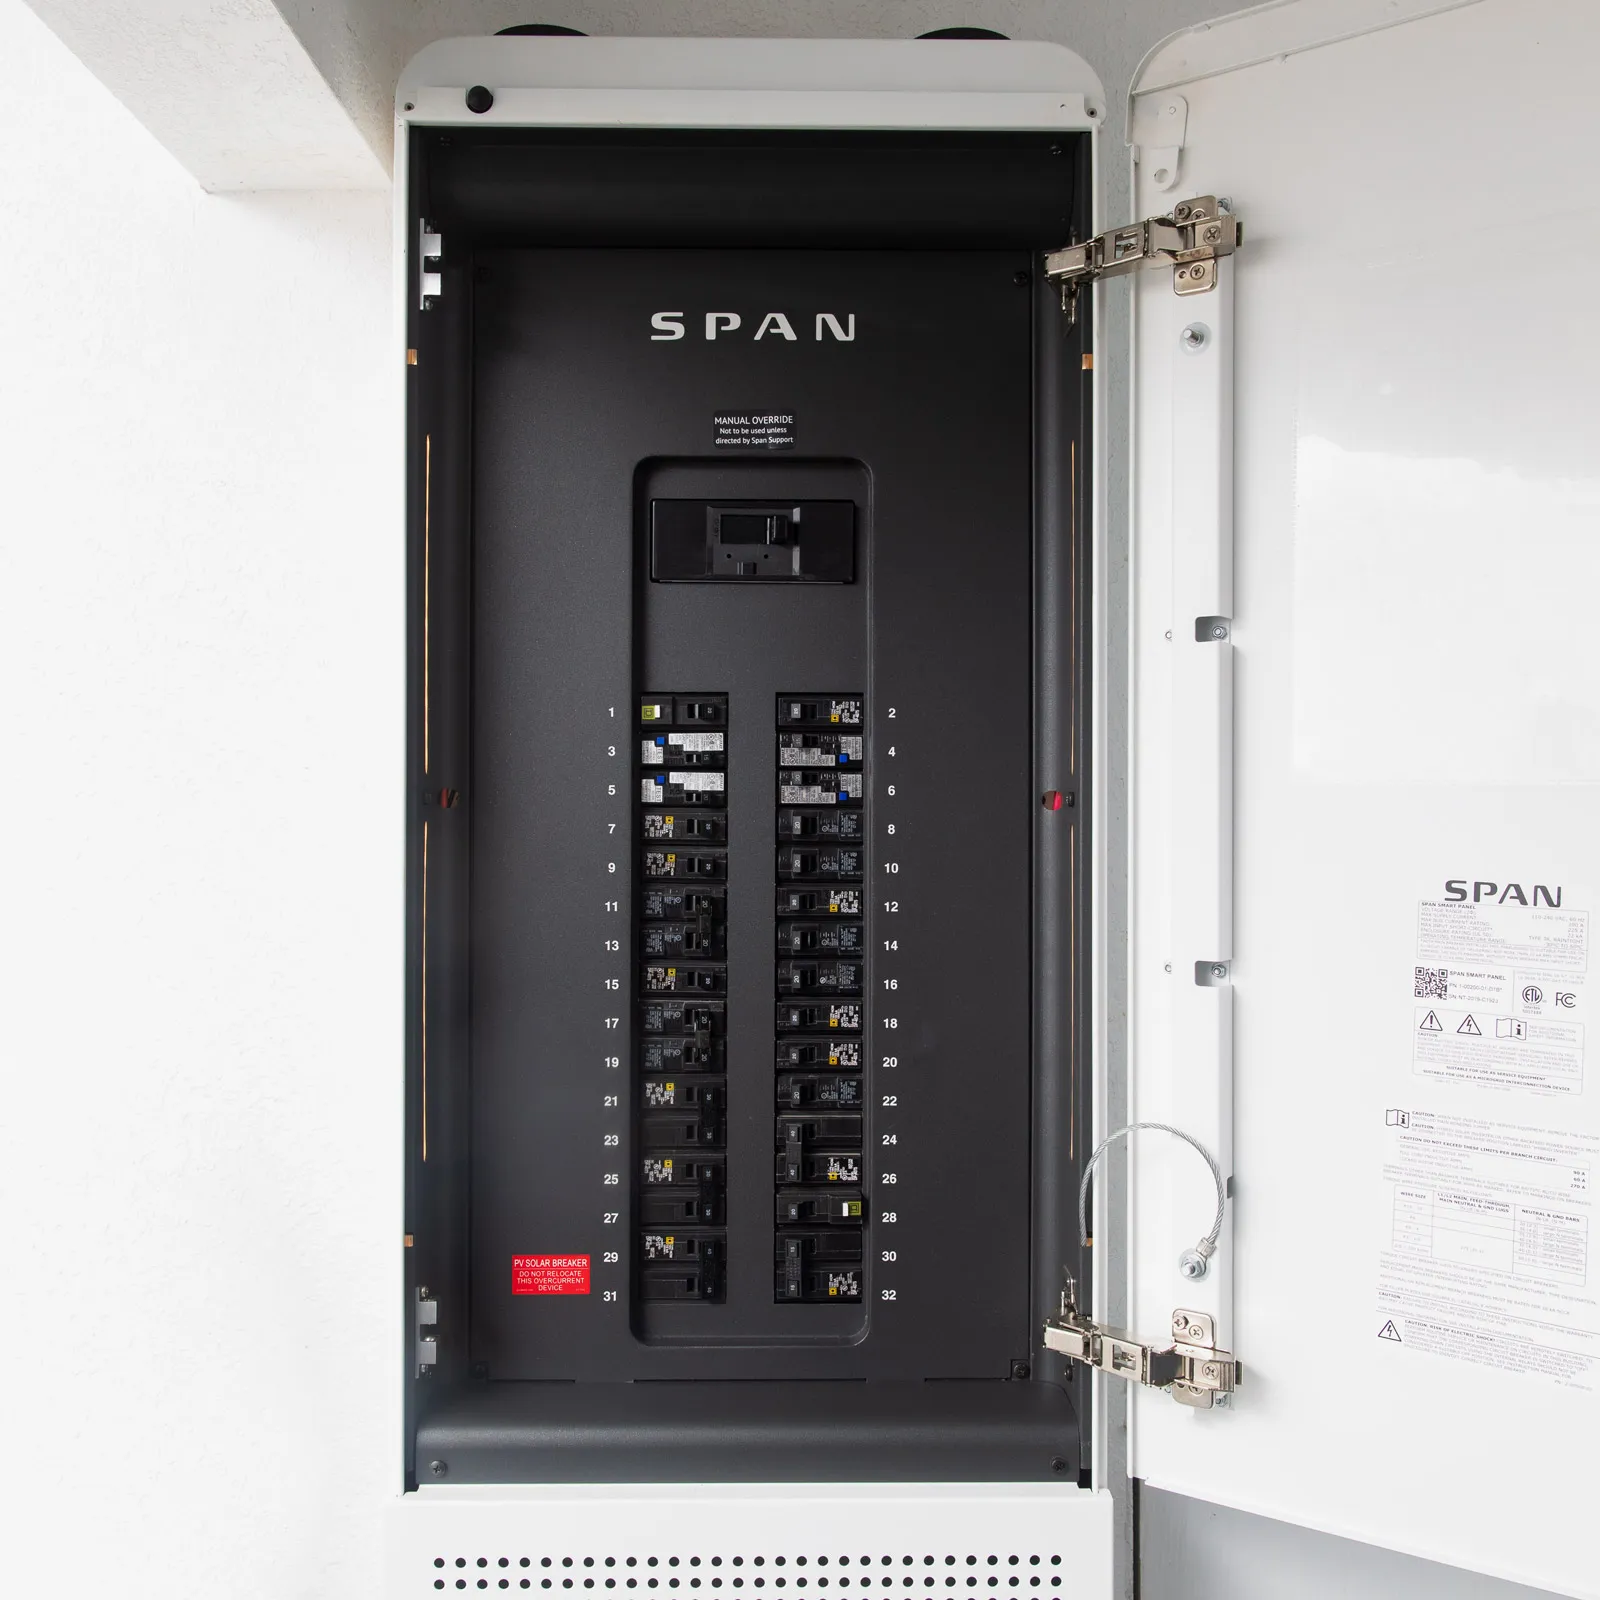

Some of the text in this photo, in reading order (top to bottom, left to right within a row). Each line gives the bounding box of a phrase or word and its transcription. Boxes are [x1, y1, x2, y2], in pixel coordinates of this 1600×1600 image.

[651, 312, 855, 340] SPAN
[714, 415, 794, 425] MANUAL OVERRIDE
[719, 427, 732, 435] Not
[766, 426, 787, 434] unless
[715, 436, 794, 446] directed by Span Support
[608, 706, 615, 718] 1
[888, 707, 896, 719] 2
[607, 745, 616, 757] 3
[887, 746, 896, 757] 4
[607, 784, 616, 796] 5
[887, 784, 896, 796] 6
[607, 823, 617, 835] 7
[887, 823, 896, 835] 8
[607, 862, 616, 874] 9
[884, 862, 899, 874] 10
[1444, 879, 1562, 908] SPAN
[604, 900, 618, 912] 11
[883, 901, 899, 913] 12
[604, 939, 620, 952] 13
[883, 940, 899, 951] 14
[1487, 973, 1507, 981] PANEL
[604, 978, 620, 990] 15
[883, 979, 898, 990] 16
[604, 1017, 620, 1029] 17
[883, 1017, 898, 1029] 18
[604, 1056, 620, 1068] 19
[882, 1056, 898, 1068] 20
[1477, 1076, 1505, 1084] MICROGRID
[1505, 1080, 1552, 1089] INTERCONNECTION
[603, 1095, 618, 1107] 21
[882, 1095, 898, 1107] 22
[603, 1134, 619, 1146] 23
[882, 1134, 898, 1146] 24
[1443, 1141, 1463, 1149] EXCEED
[1510, 1151, 1533, 1159] BRANCH
[603, 1173, 619, 1185] 25
[881, 1173, 897, 1185] 26
[1454, 1199, 1477, 1208] NEUTRAL
[603, 1212, 619, 1224] 27
[881, 1211, 897, 1223] 28
[1521, 1209, 1546, 1217] NEUTRAL
[603, 1251, 619, 1263] 29
[881, 1250, 897, 1262] 30
[514, 1258, 588, 1268] PV SOLAR BREAKER
[519, 1270, 582, 1278] DO NOT RELOCATE
[517, 1277, 585, 1285] THIS OVERCURRENT
[603, 1290, 617, 1302] 31
[881, 1289, 897, 1301] 32
[1450, 1328, 1475, 1338] ELECTRIC
